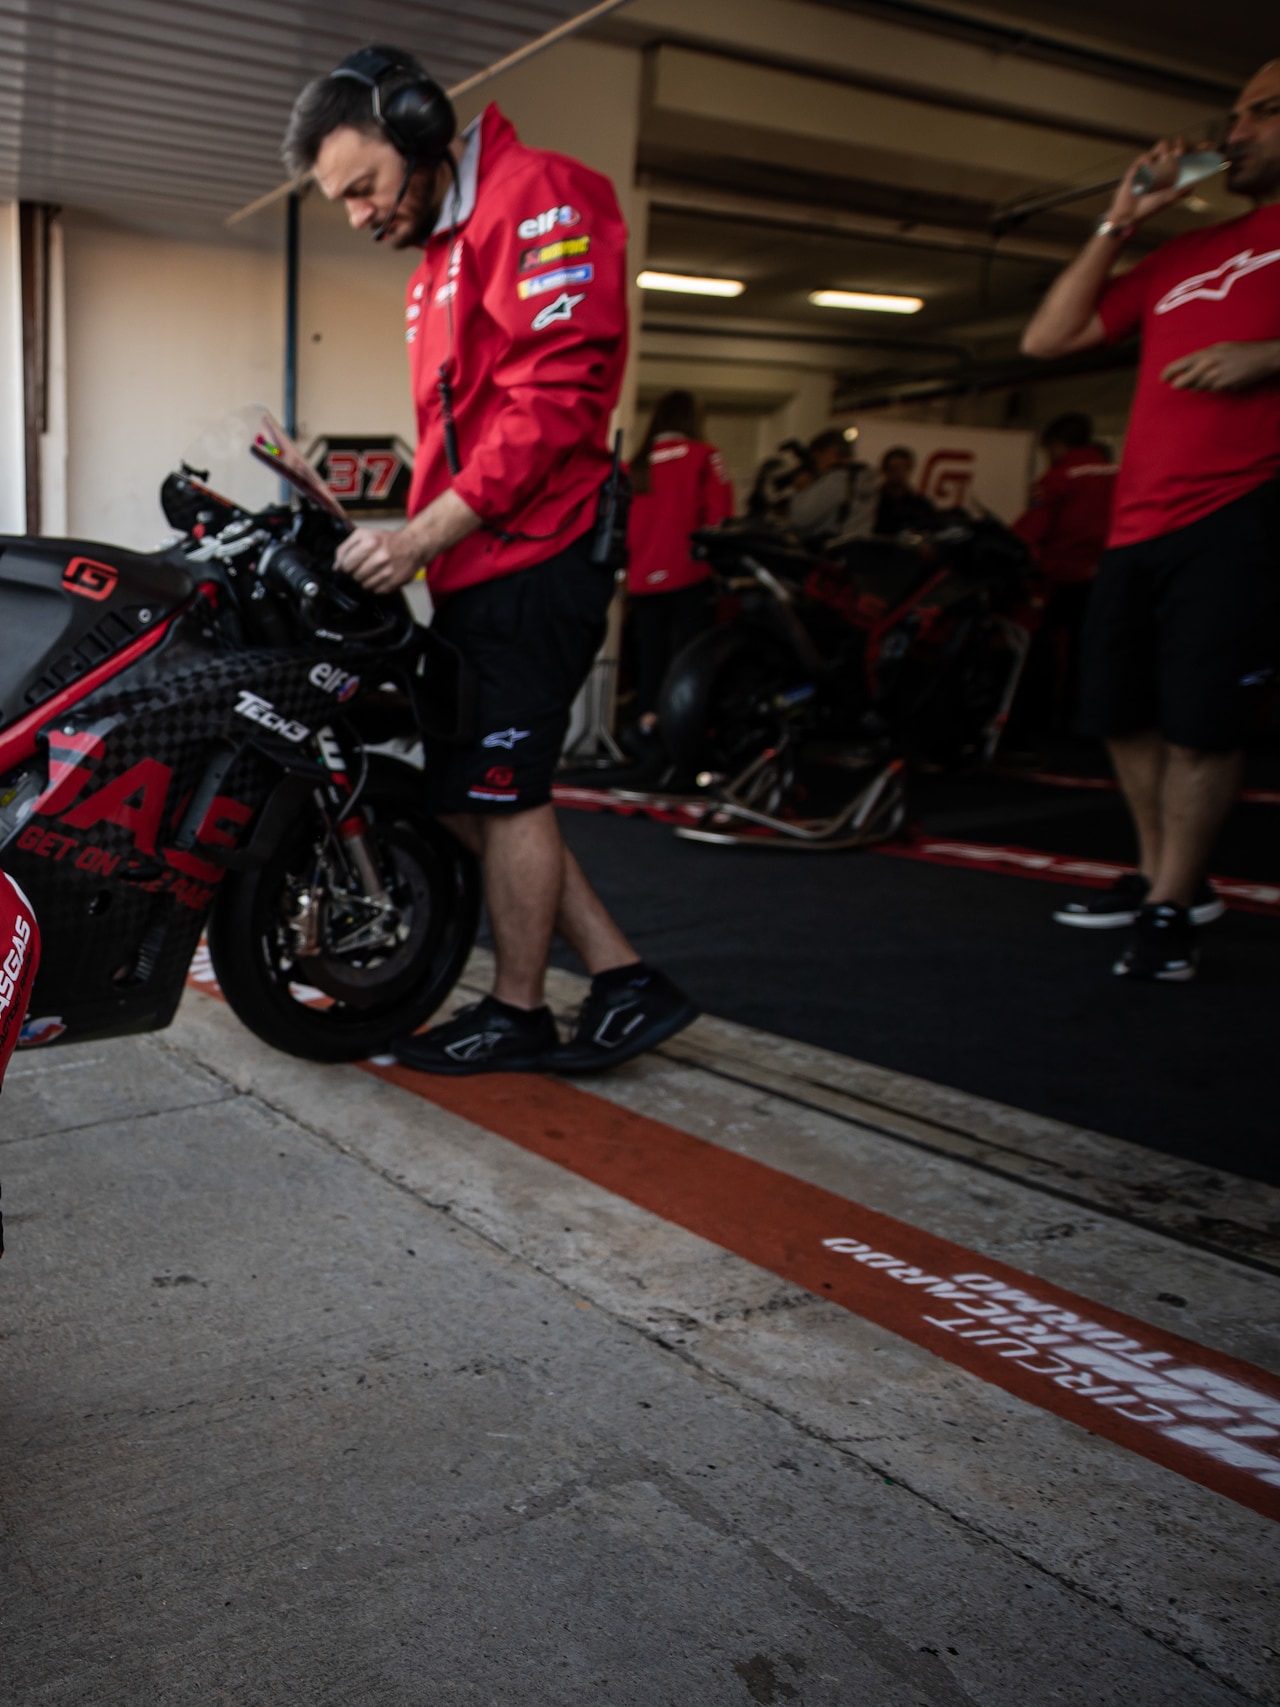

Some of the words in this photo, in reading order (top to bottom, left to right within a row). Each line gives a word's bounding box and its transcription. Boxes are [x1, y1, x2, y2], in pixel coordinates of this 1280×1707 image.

[518, 207, 560, 239] elf
[326, 449, 403, 499] 37
[308, 662, 347, 693] elf
[17, 825, 79, 862] GET
[76, 846, 122, 876] ON
[821, 1236, 1073, 1345] RICARDO
[951, 1273, 1175, 1369] TORMO
[923, 1314, 1176, 1423] CIRCUIT
